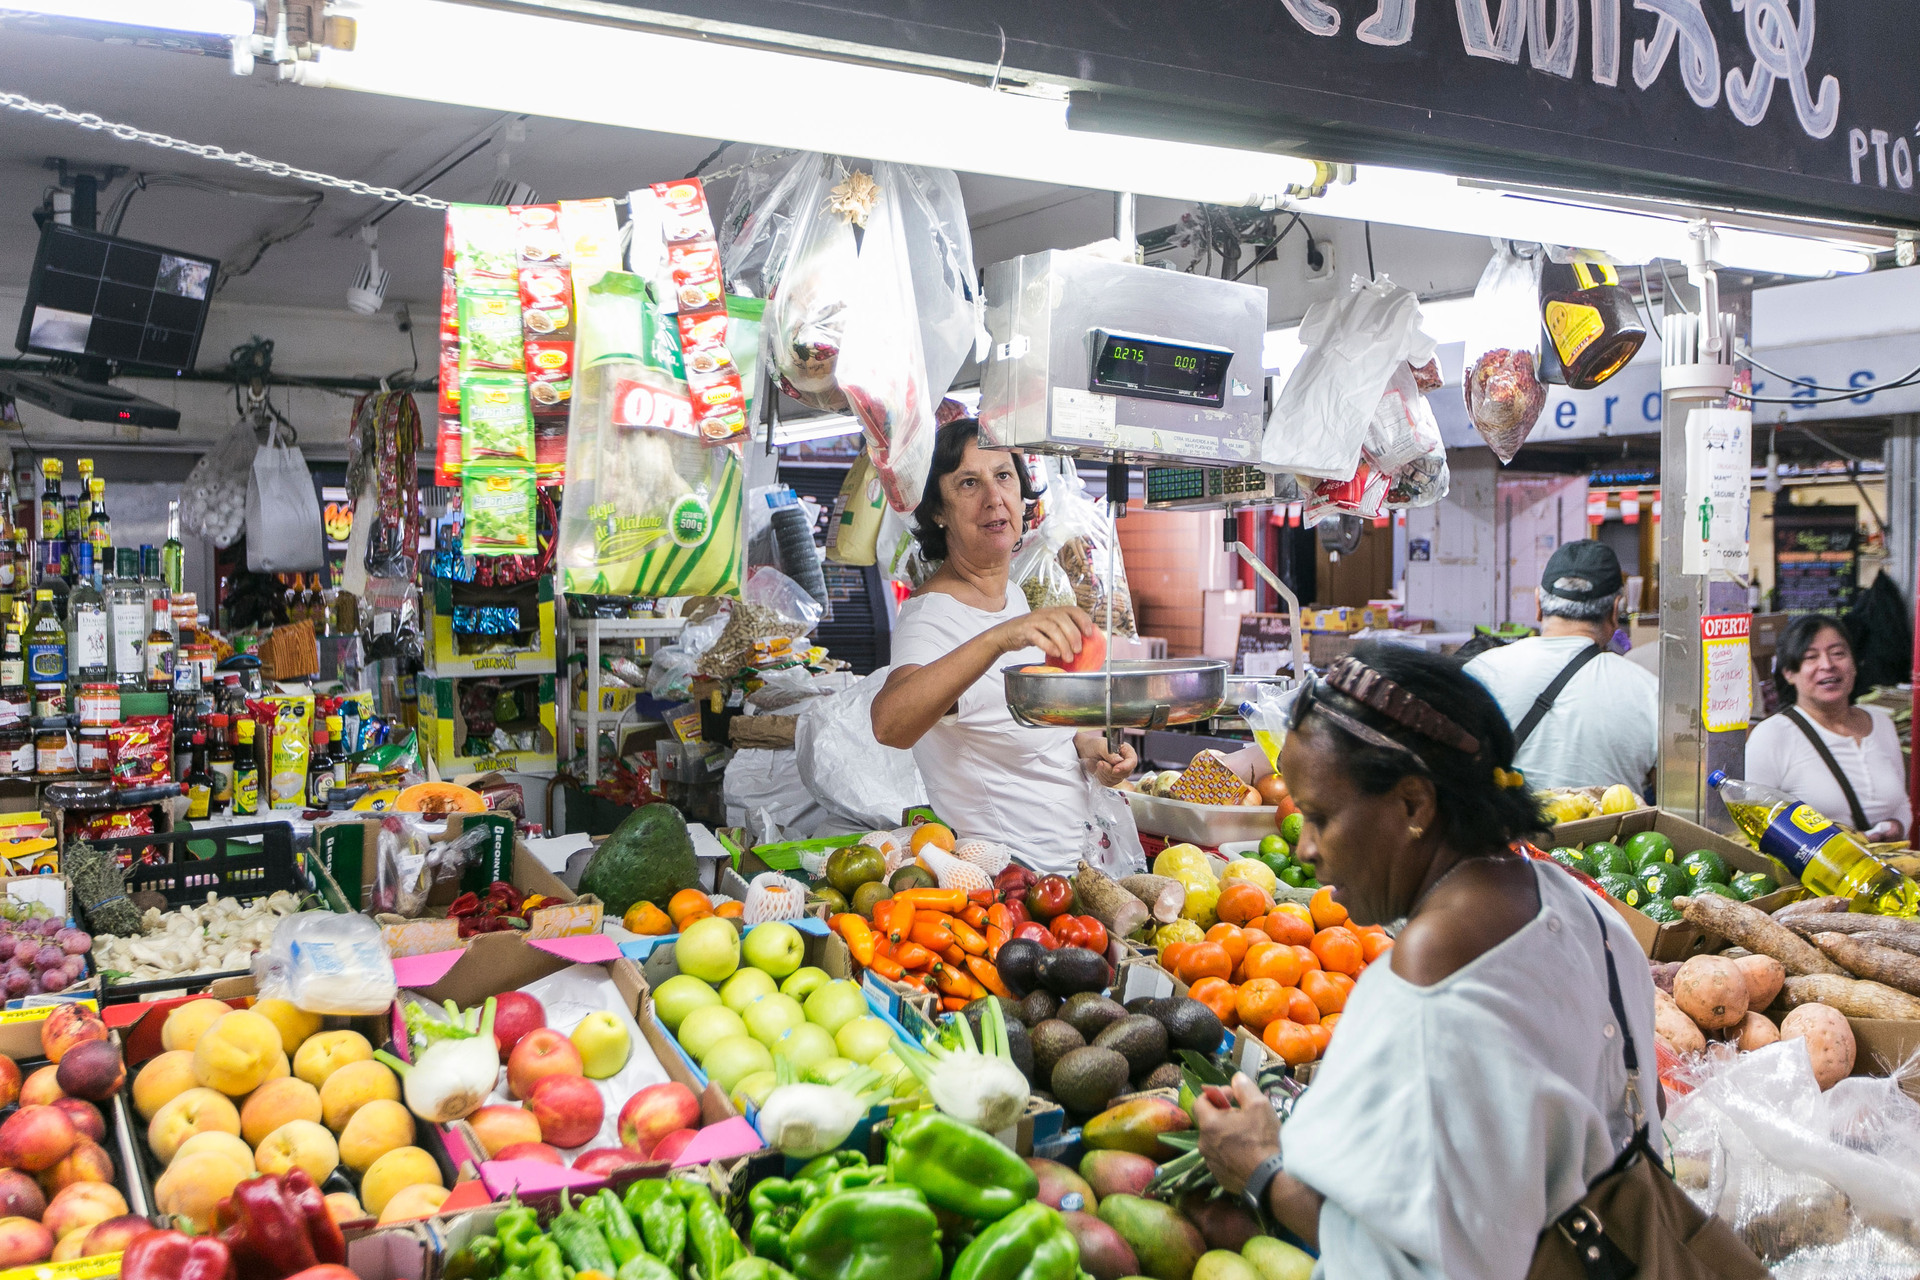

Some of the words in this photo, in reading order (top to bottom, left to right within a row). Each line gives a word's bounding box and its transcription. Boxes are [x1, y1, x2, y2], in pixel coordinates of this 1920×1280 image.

[1114, 346, 1144, 362] 0.275
[1174, 355, 1197, 369] 0.00
[587, 501, 617, 521] Hoja
[595, 524, 608, 541] de
[613, 515, 662, 532] Plátano
[680, 518, 697, 530] 500
[696, 521, 703, 532] g
[1704, 617, 1750, 637] OFERTA
